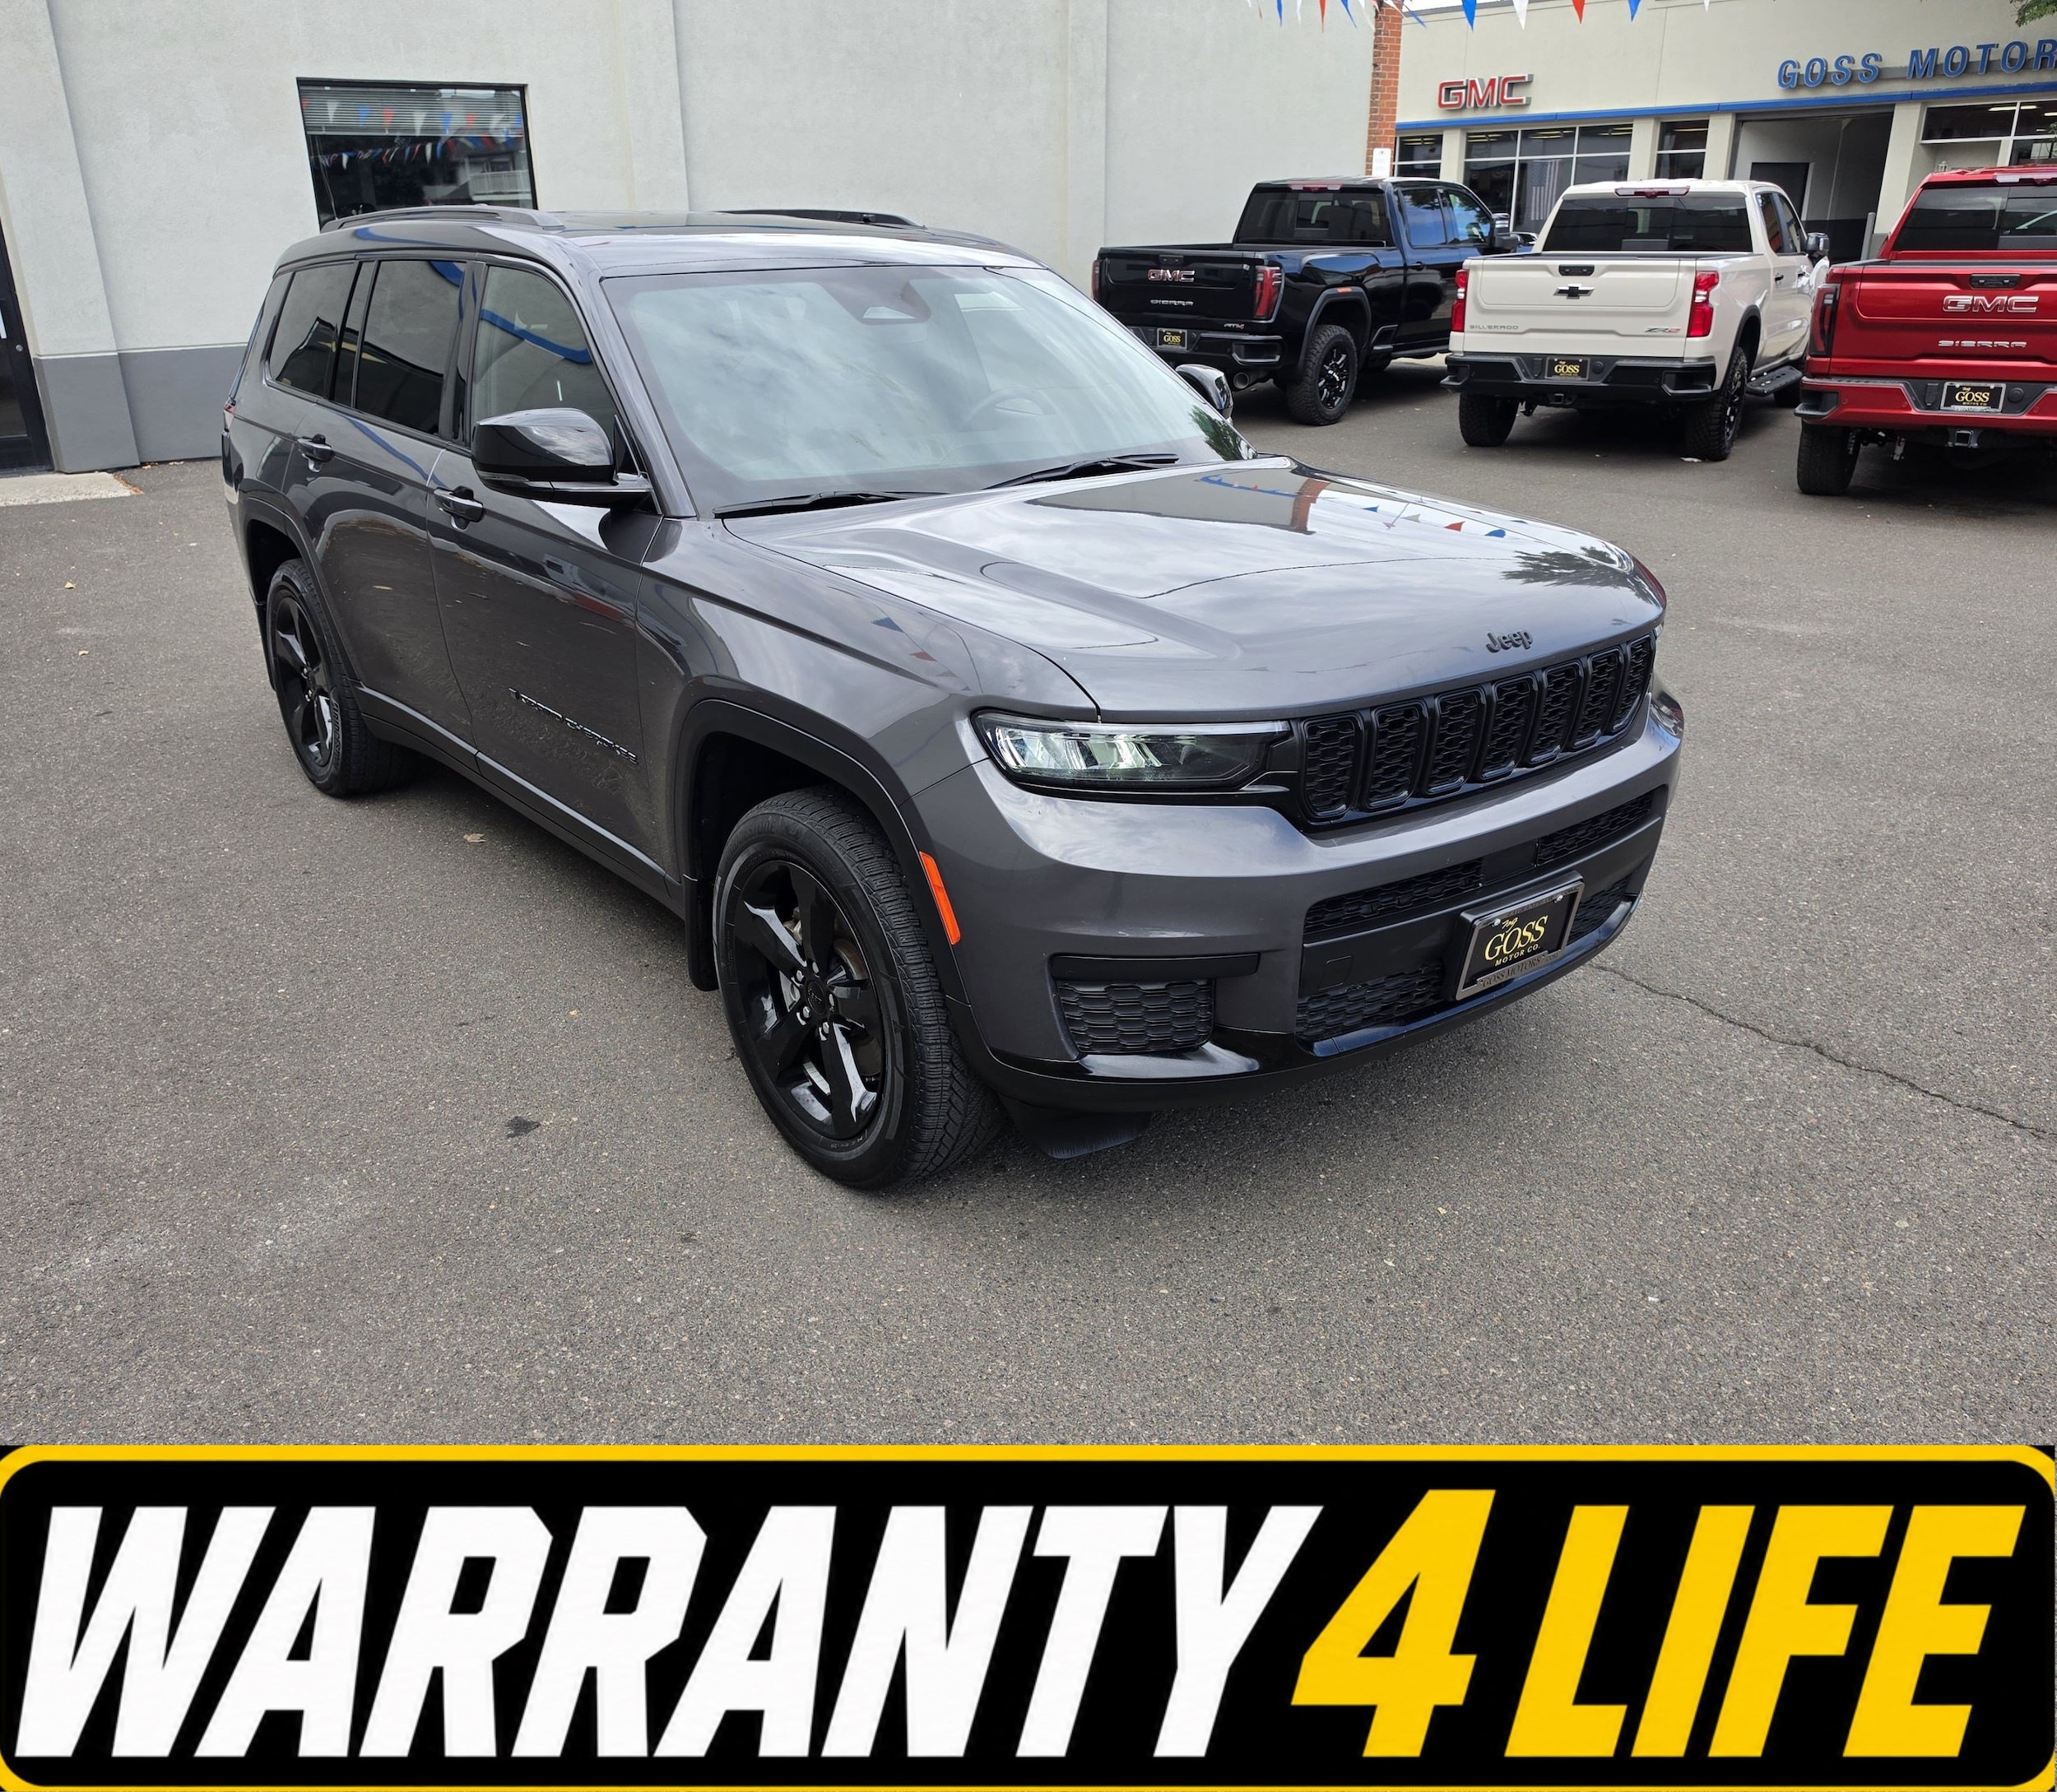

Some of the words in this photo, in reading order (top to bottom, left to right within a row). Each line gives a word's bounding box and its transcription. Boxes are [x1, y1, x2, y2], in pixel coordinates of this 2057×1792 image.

[1777, 53, 1882, 90] GOSS
[1906, 39, 2057, 80] MOTOR
[1437, 75, 1532, 109] GMC
[1148, 269, 1195, 282] GMC
[1943, 295, 2039, 313] GMC
[1163, 334, 1182, 343] GOSS
[1938, 340, 2027, 348] SIERRA
[1554, 364, 1580, 374] GOSS
[1955, 391, 1990, 402] GOSS
[1485, 629, 1534, 652] Jeep
[1484, 915, 1549, 961] GOSS
[1495, 949, 1525, 967] MOTOR
[1527, 943, 1541, 954] CO.
